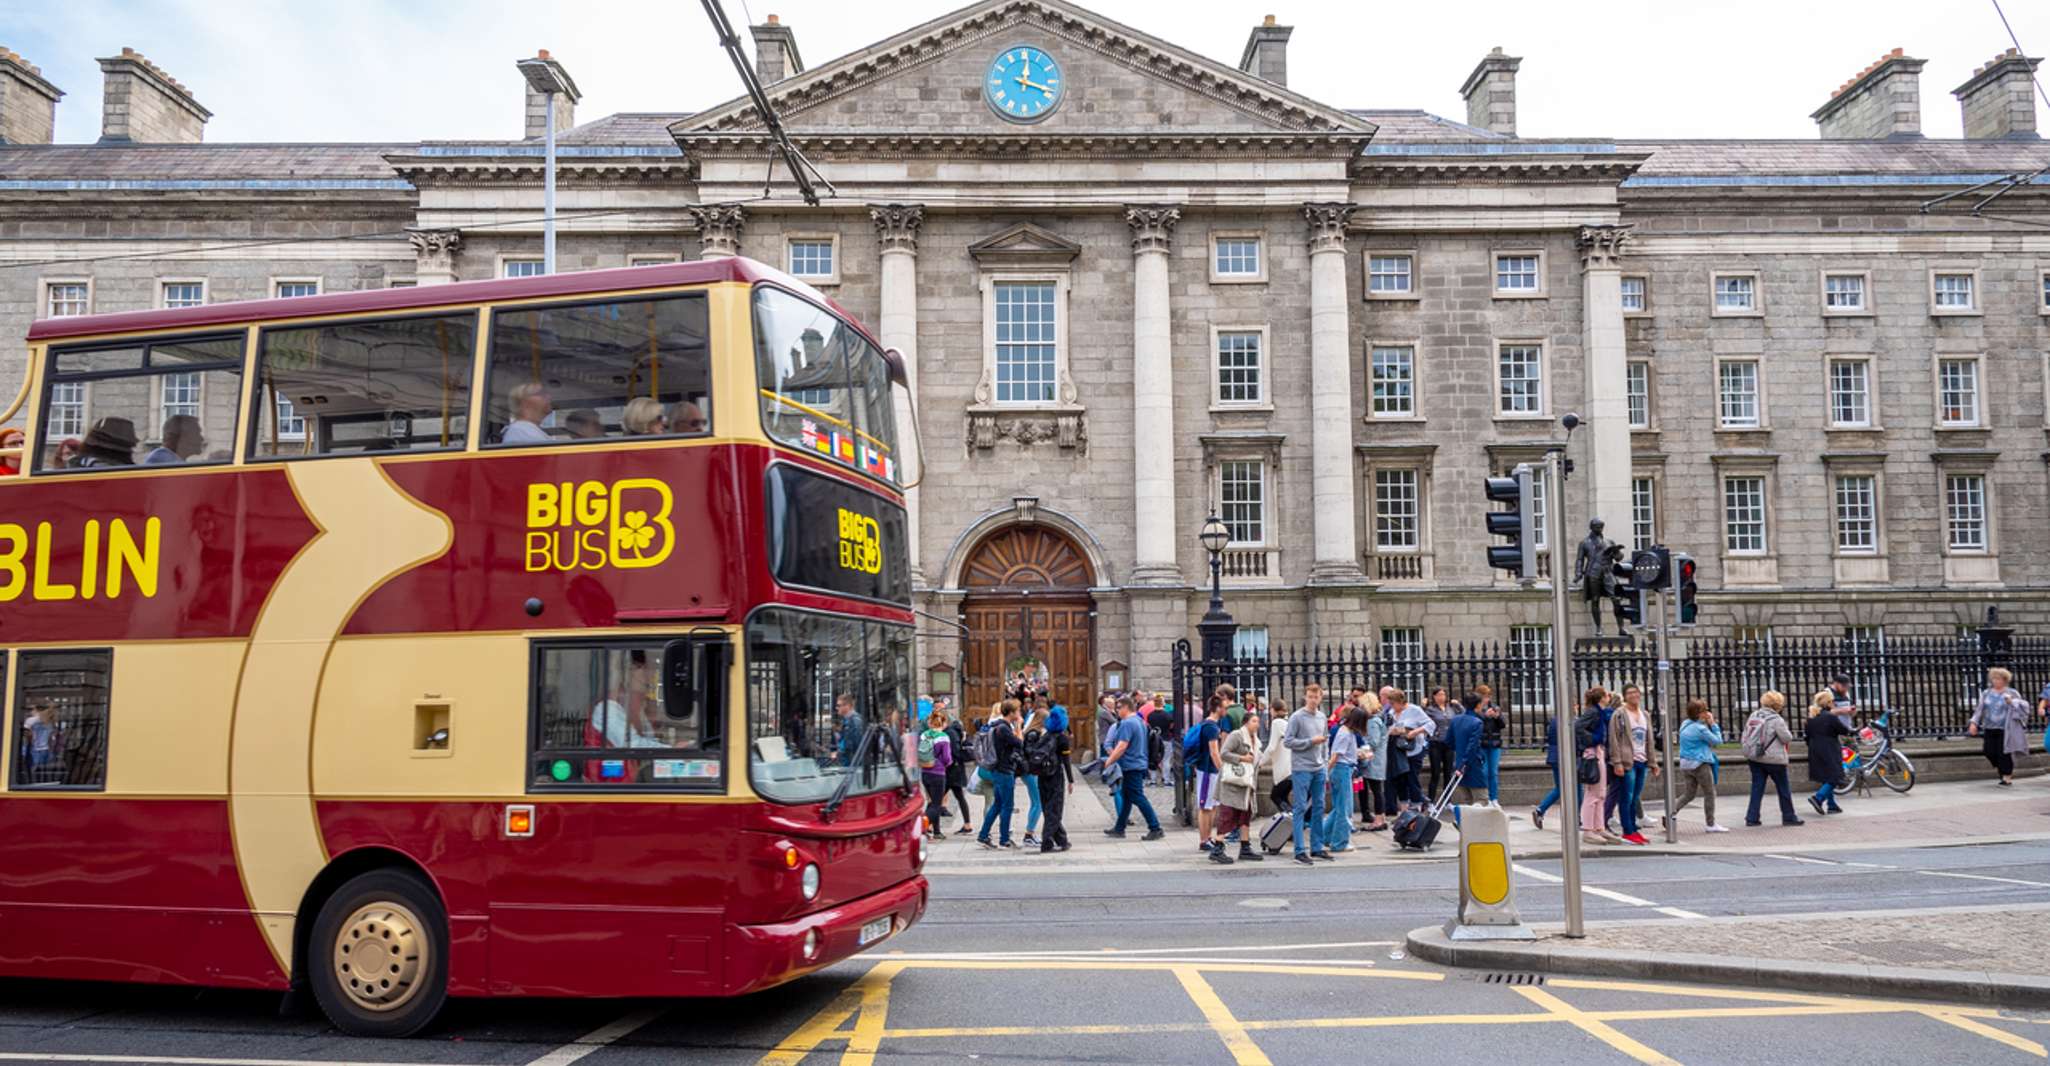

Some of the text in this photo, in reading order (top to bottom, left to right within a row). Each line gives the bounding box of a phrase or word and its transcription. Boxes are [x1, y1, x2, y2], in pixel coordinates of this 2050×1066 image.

[527, 480, 609, 528] BIG
[838, 508, 864, 543] BIG
[526, 530, 607, 571] BUS
[839, 540, 866, 571] BUS
